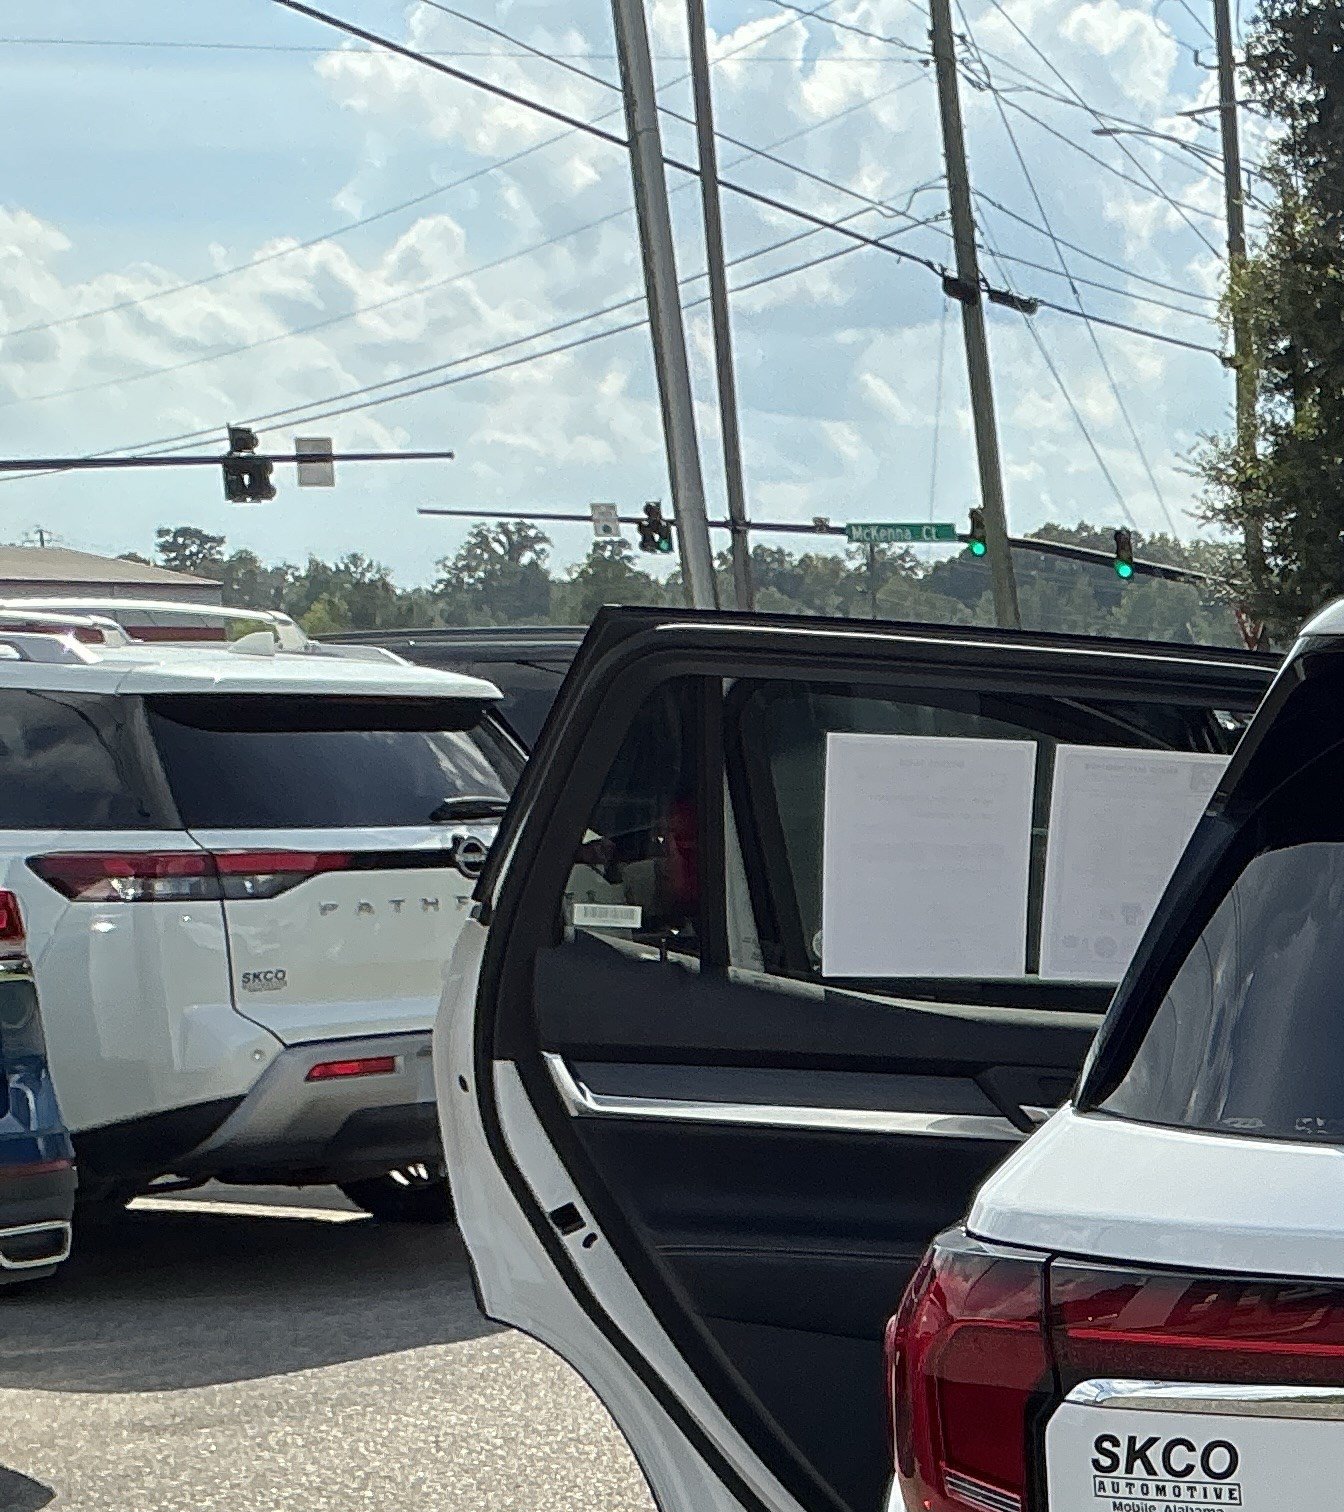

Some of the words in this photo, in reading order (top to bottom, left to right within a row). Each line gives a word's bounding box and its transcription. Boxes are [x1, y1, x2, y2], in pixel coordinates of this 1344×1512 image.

[851, 525, 912, 540] McKenna
[242, 969, 287, 984] SKCO
[1091, 1433, 1239, 1480] SKCO
[1097, 1481, 1239, 1501] AUTOMOTIVE
